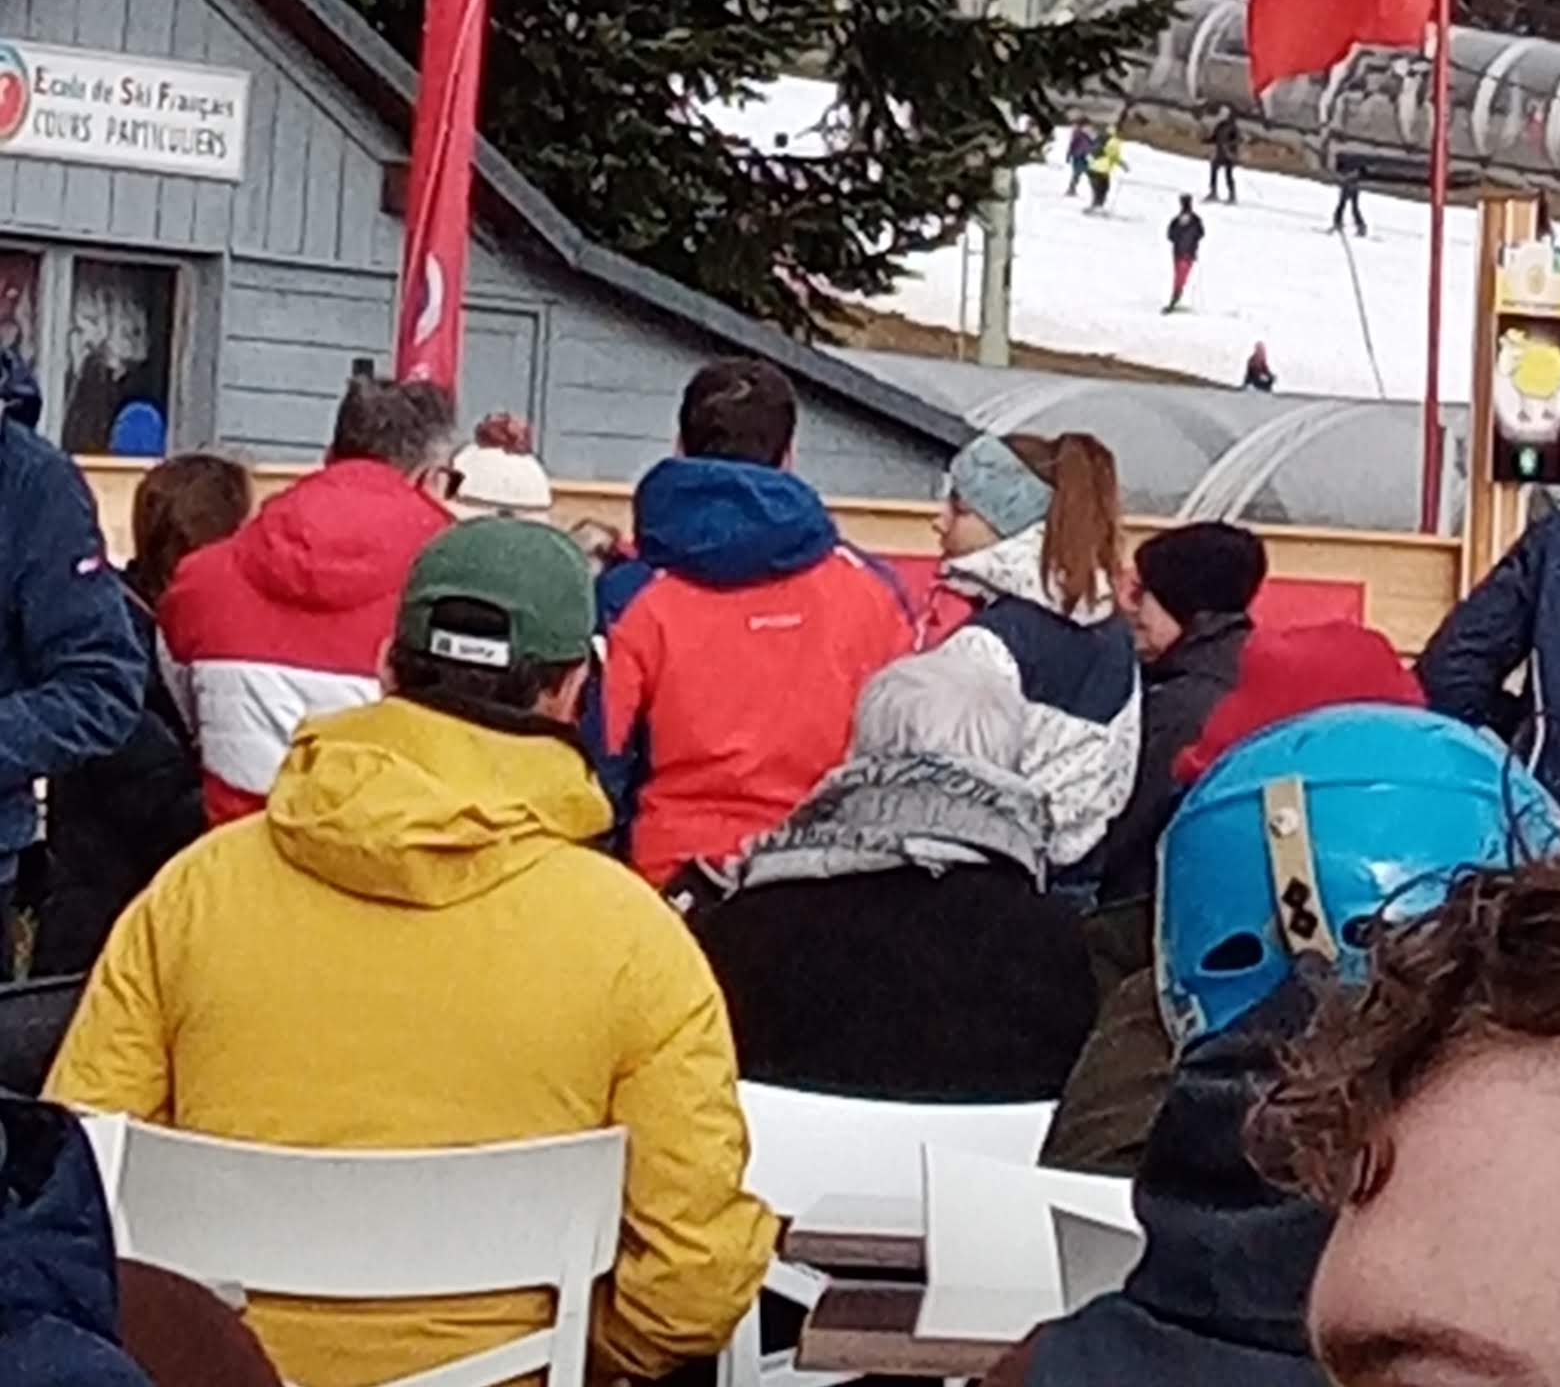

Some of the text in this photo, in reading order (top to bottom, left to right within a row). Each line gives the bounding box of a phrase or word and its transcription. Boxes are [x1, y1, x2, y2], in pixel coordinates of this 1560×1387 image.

[91, 78, 113, 105] de
[120, 76, 152, 110] Ski
[157, 82, 235, 120] Français
[33, 108, 227, 159] COURS PARTICULIERS
